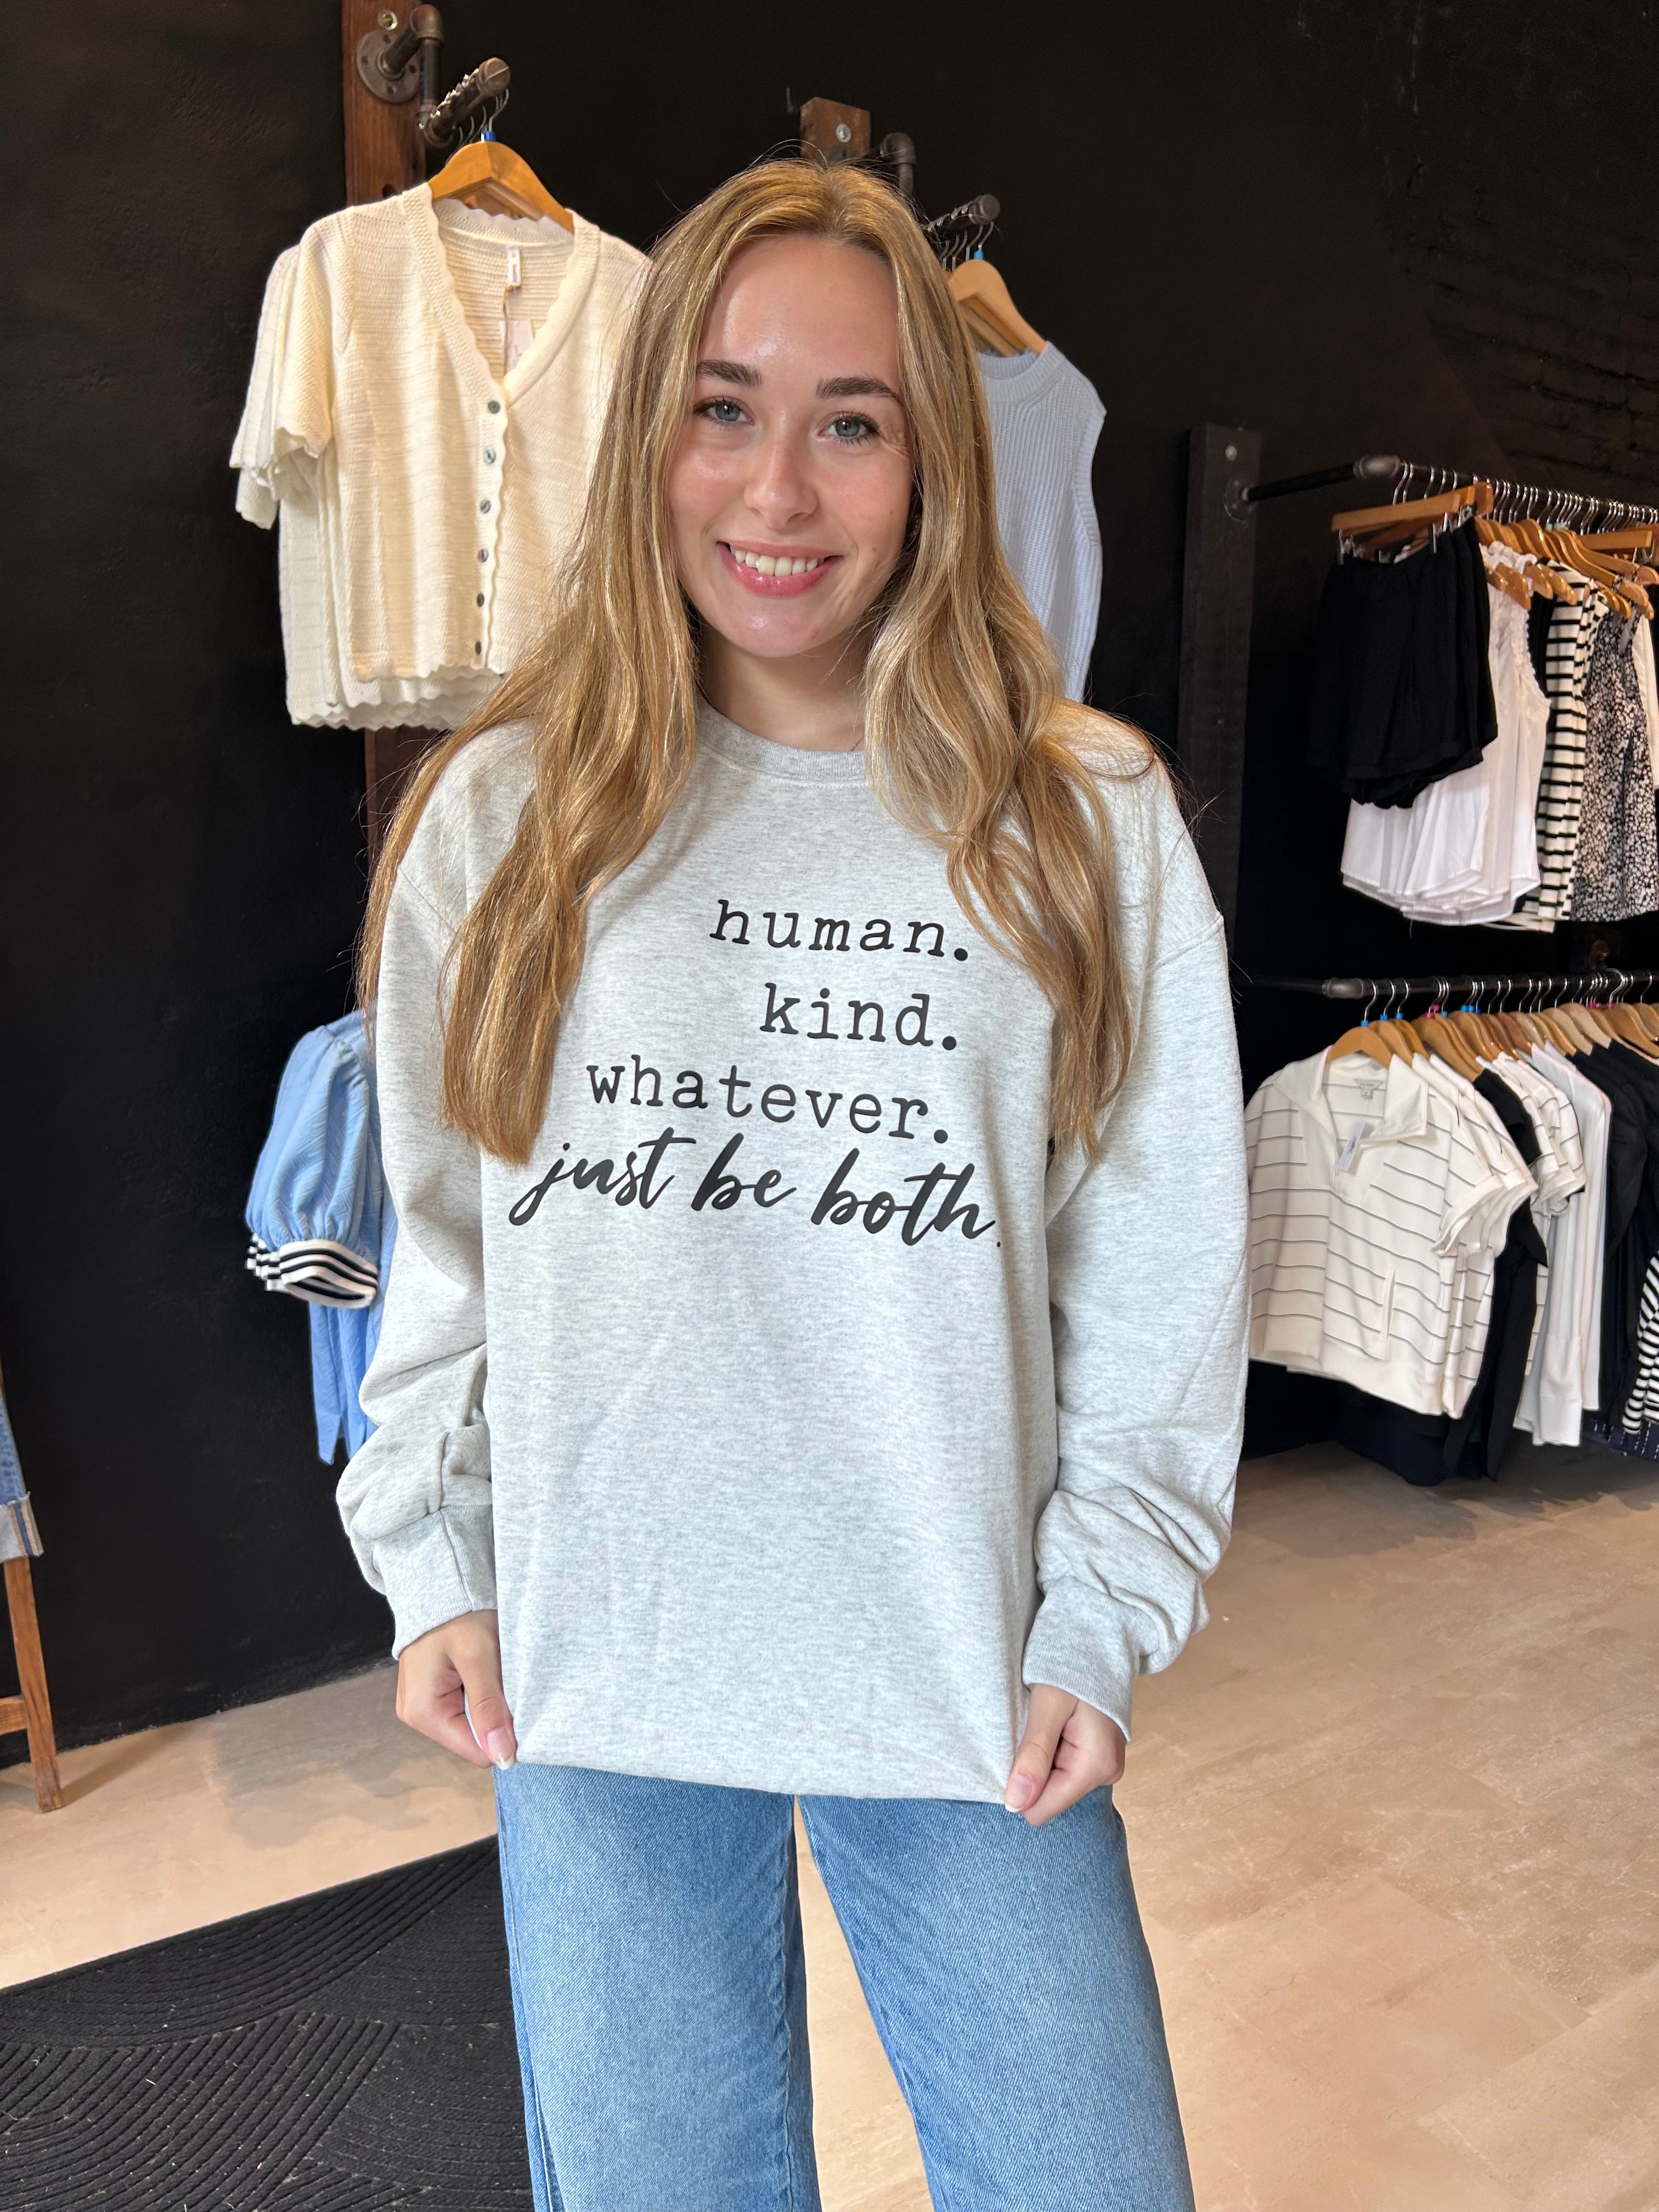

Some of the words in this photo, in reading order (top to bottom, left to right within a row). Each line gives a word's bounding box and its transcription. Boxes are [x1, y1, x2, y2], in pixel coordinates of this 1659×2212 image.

[709, 898, 969, 962] human.
[759, 981, 957, 1051] kind.
[585, 1054, 949, 1144] whatever.
[508, 1126, 697, 1227] just
[691, 1132, 798, 1212] be
